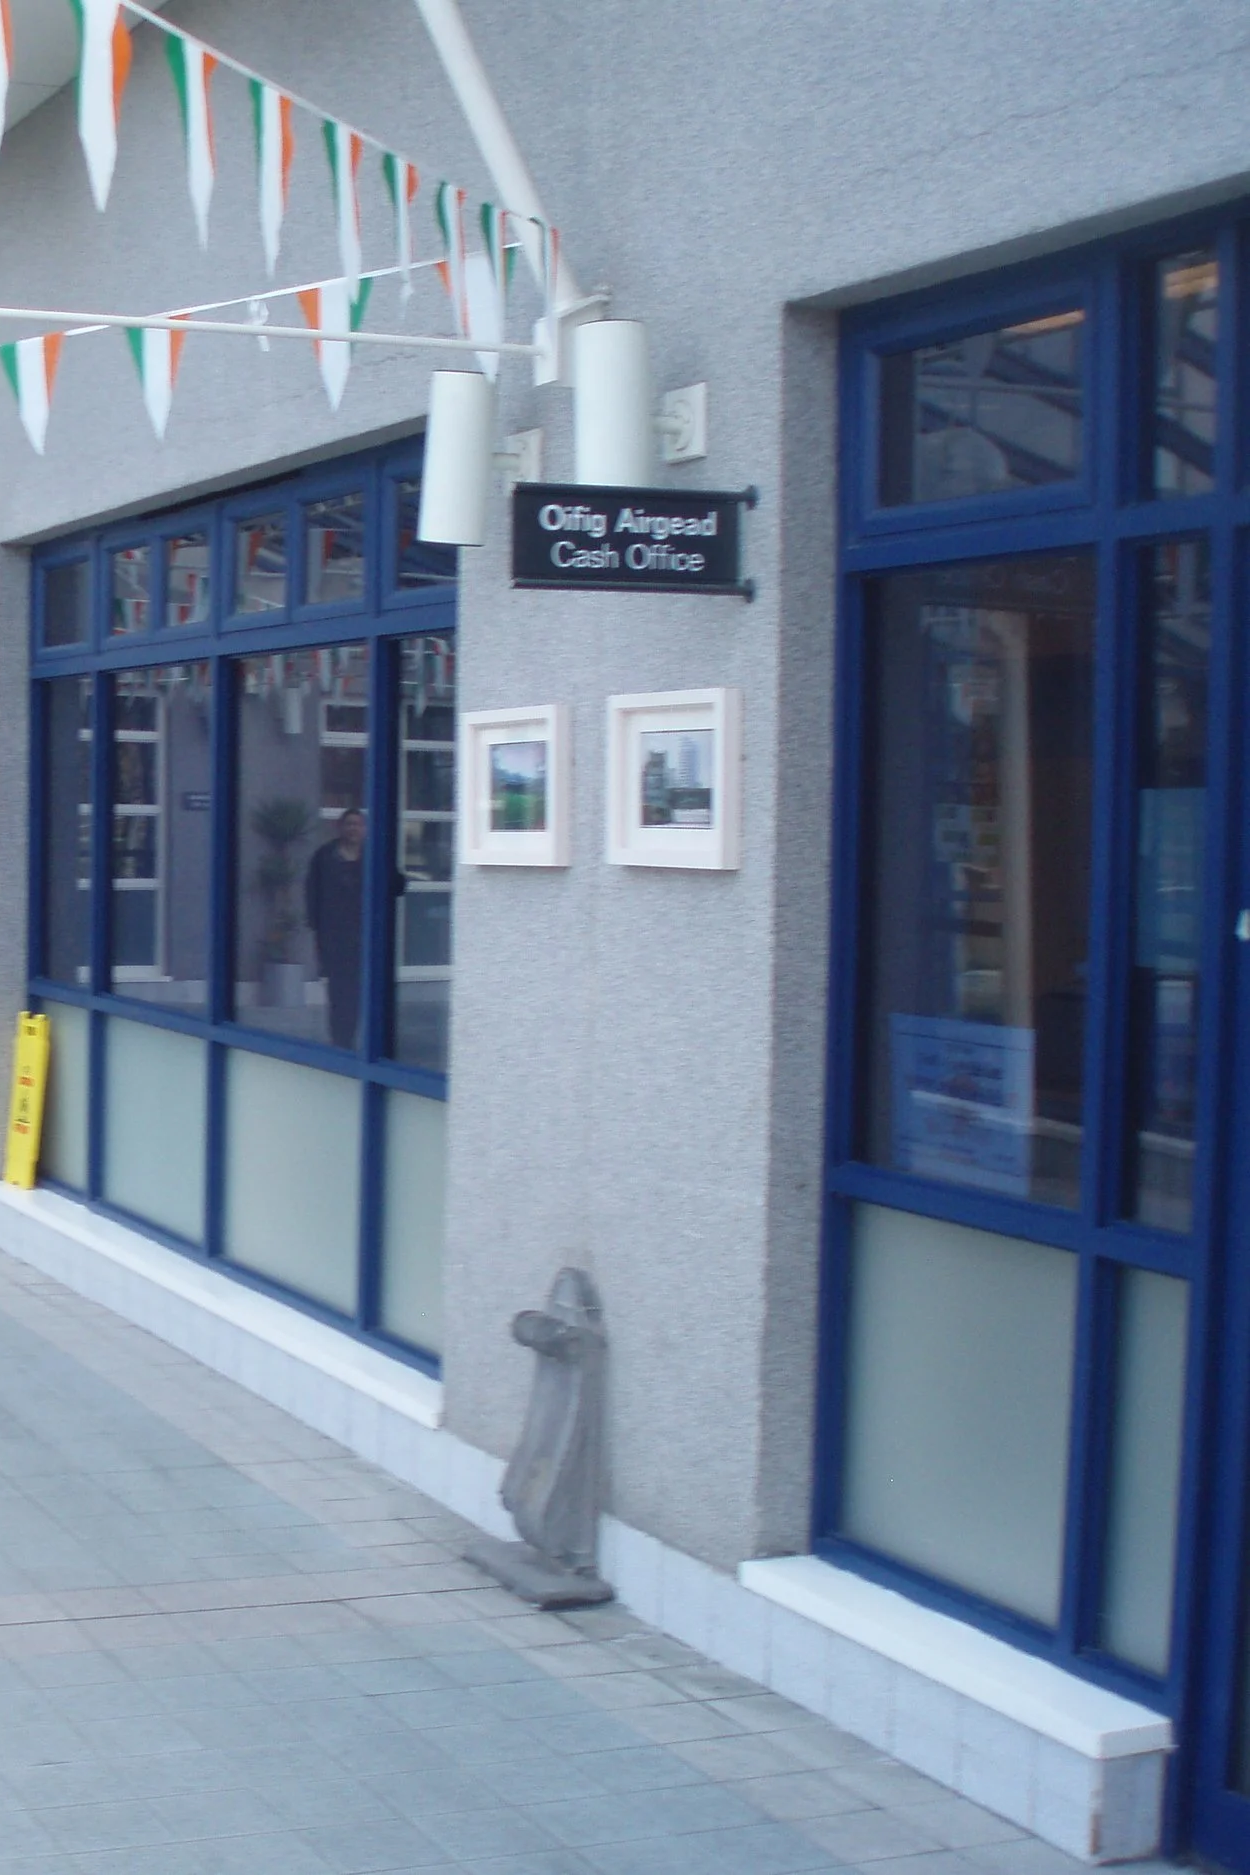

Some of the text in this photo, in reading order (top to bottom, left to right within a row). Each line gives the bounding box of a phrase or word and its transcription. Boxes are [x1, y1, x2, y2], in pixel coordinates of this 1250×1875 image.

[538, 504, 718, 540] Oifig Airgead
[550, 541, 706, 572] Cash Office
